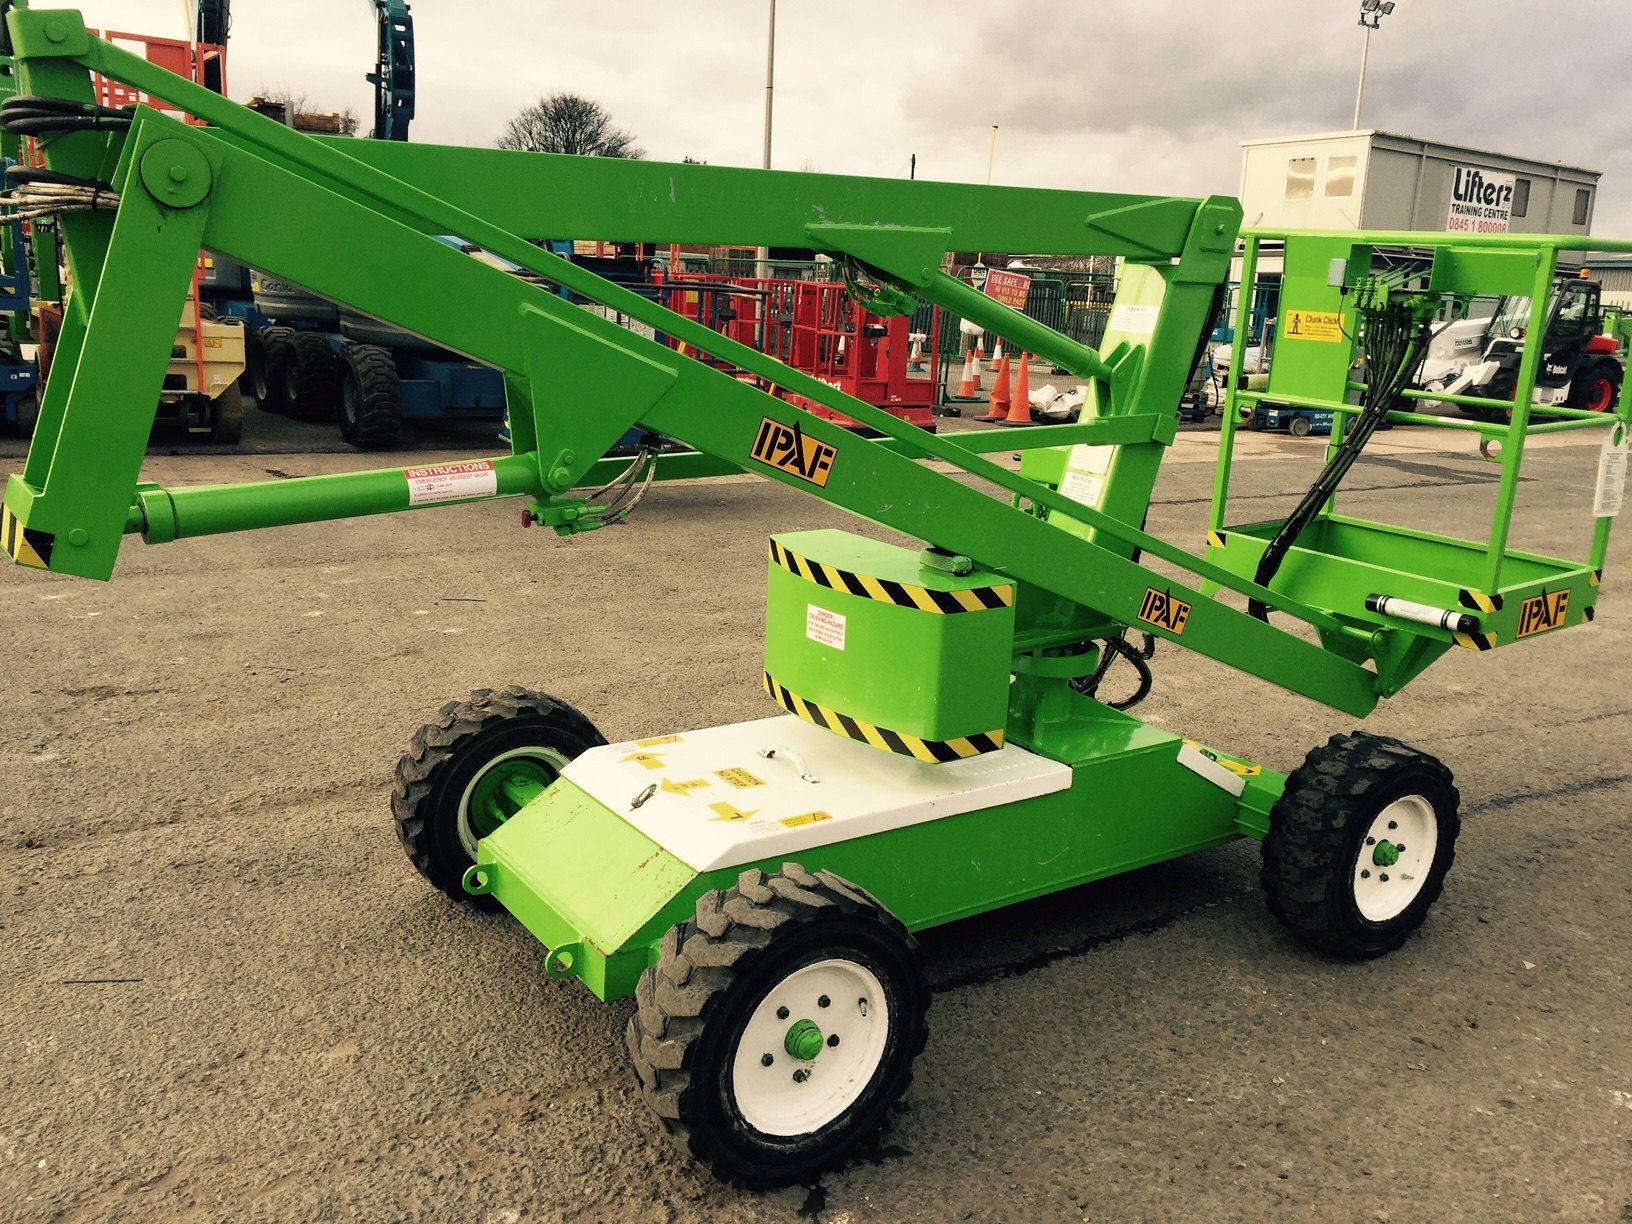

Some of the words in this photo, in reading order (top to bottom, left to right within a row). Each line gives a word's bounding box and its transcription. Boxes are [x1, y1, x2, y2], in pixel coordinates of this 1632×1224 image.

[1453, 168, 1512, 207] Lifterz
[1451, 203, 1483, 217] TRAINING
[1483, 208, 1509, 220] CENTRE
[1449, 217, 1469, 231] 0845
[1471, 220, 1476, 232] 1
[1477, 221, 1507, 233] 800008
[1003, 276, 1018, 286] SAFE
[1011, 288, 1018, 297] TO
[1305, 314, 1322, 324] Clunk
[753, 420, 834, 479] IPAF
[408, 461, 490, 477] INSTRUCTIONS
[415, 476, 448, 485] EMERGENCY
[449, 473, 473, 482] DESCENT
[474, 471, 490, 479] VALVE
[1071, 474, 1092, 484] NOTICE
[1139, 586, 1189, 630] IPAF
[1519, 587, 1568, 635] IPAF
[731, 767, 763, 786] CAUTION
